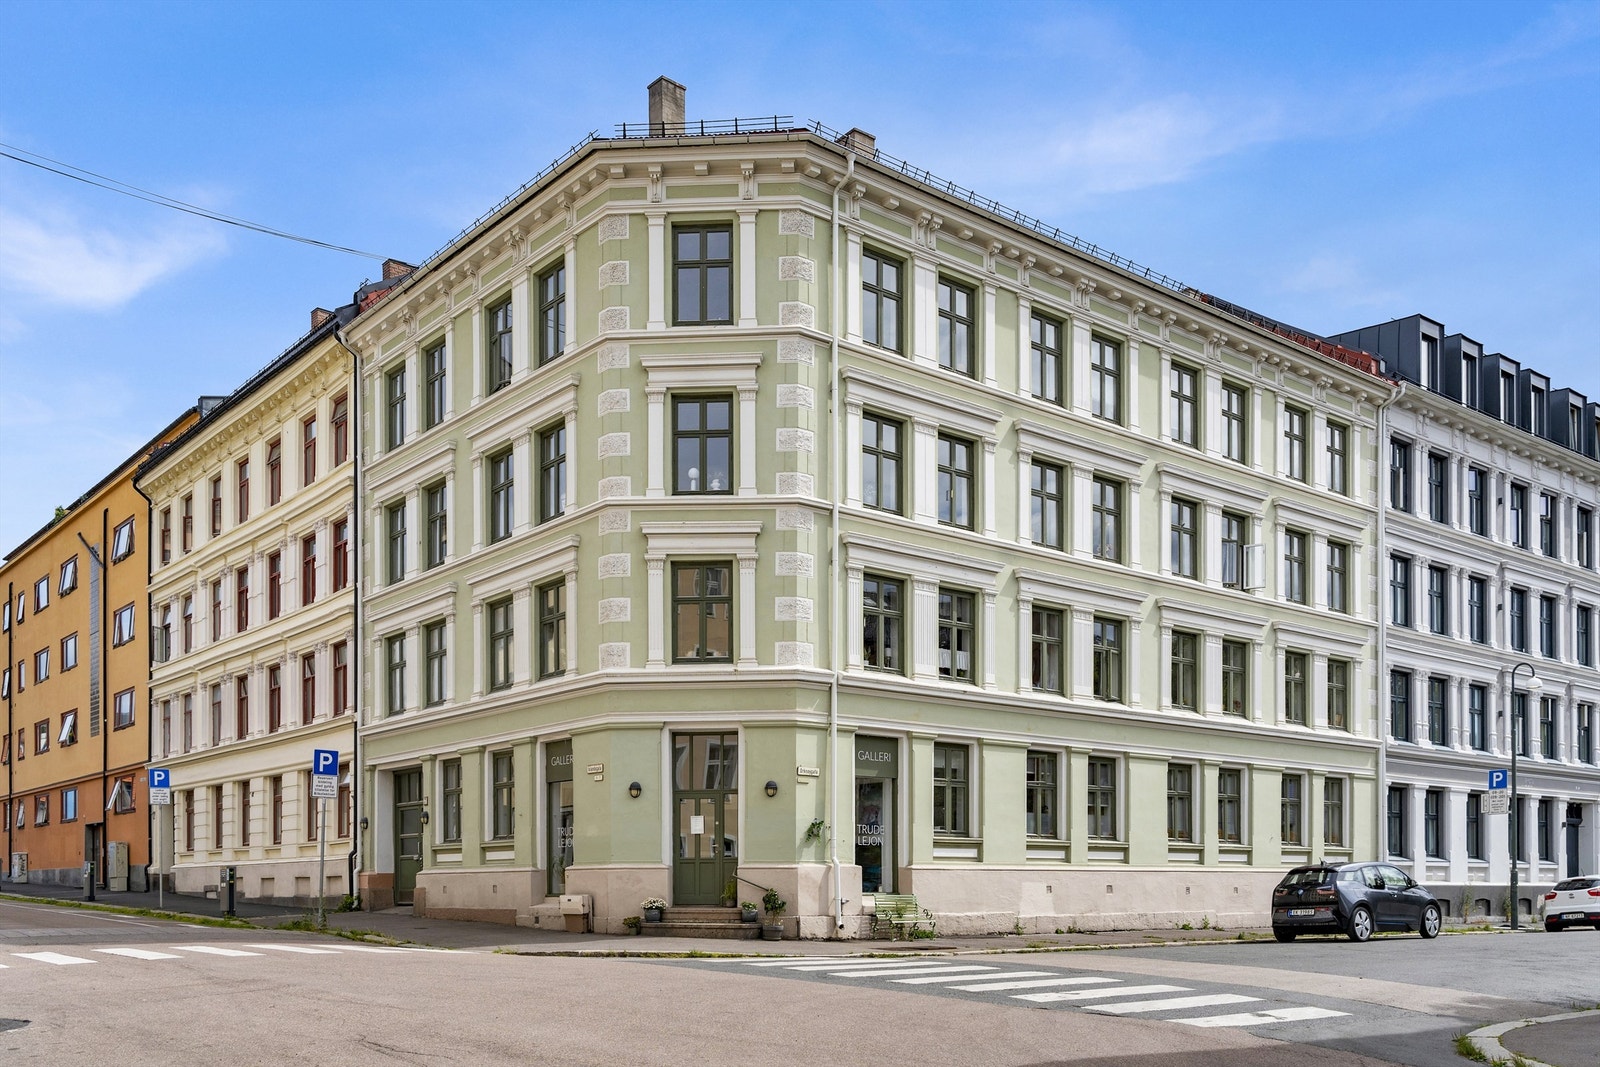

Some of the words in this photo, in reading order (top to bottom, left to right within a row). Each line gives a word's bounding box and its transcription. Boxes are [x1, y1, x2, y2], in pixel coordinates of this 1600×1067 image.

[319, 752, 333, 772] P
[551, 754, 574, 766] GALLER
[857, 750, 891, 762] GALLERI
[154, 771, 165, 786] P
[1492, 772, 1503, 787] P
[857, 824, 885, 835] TRUDE
[857, 836, 884, 846] LEJON
